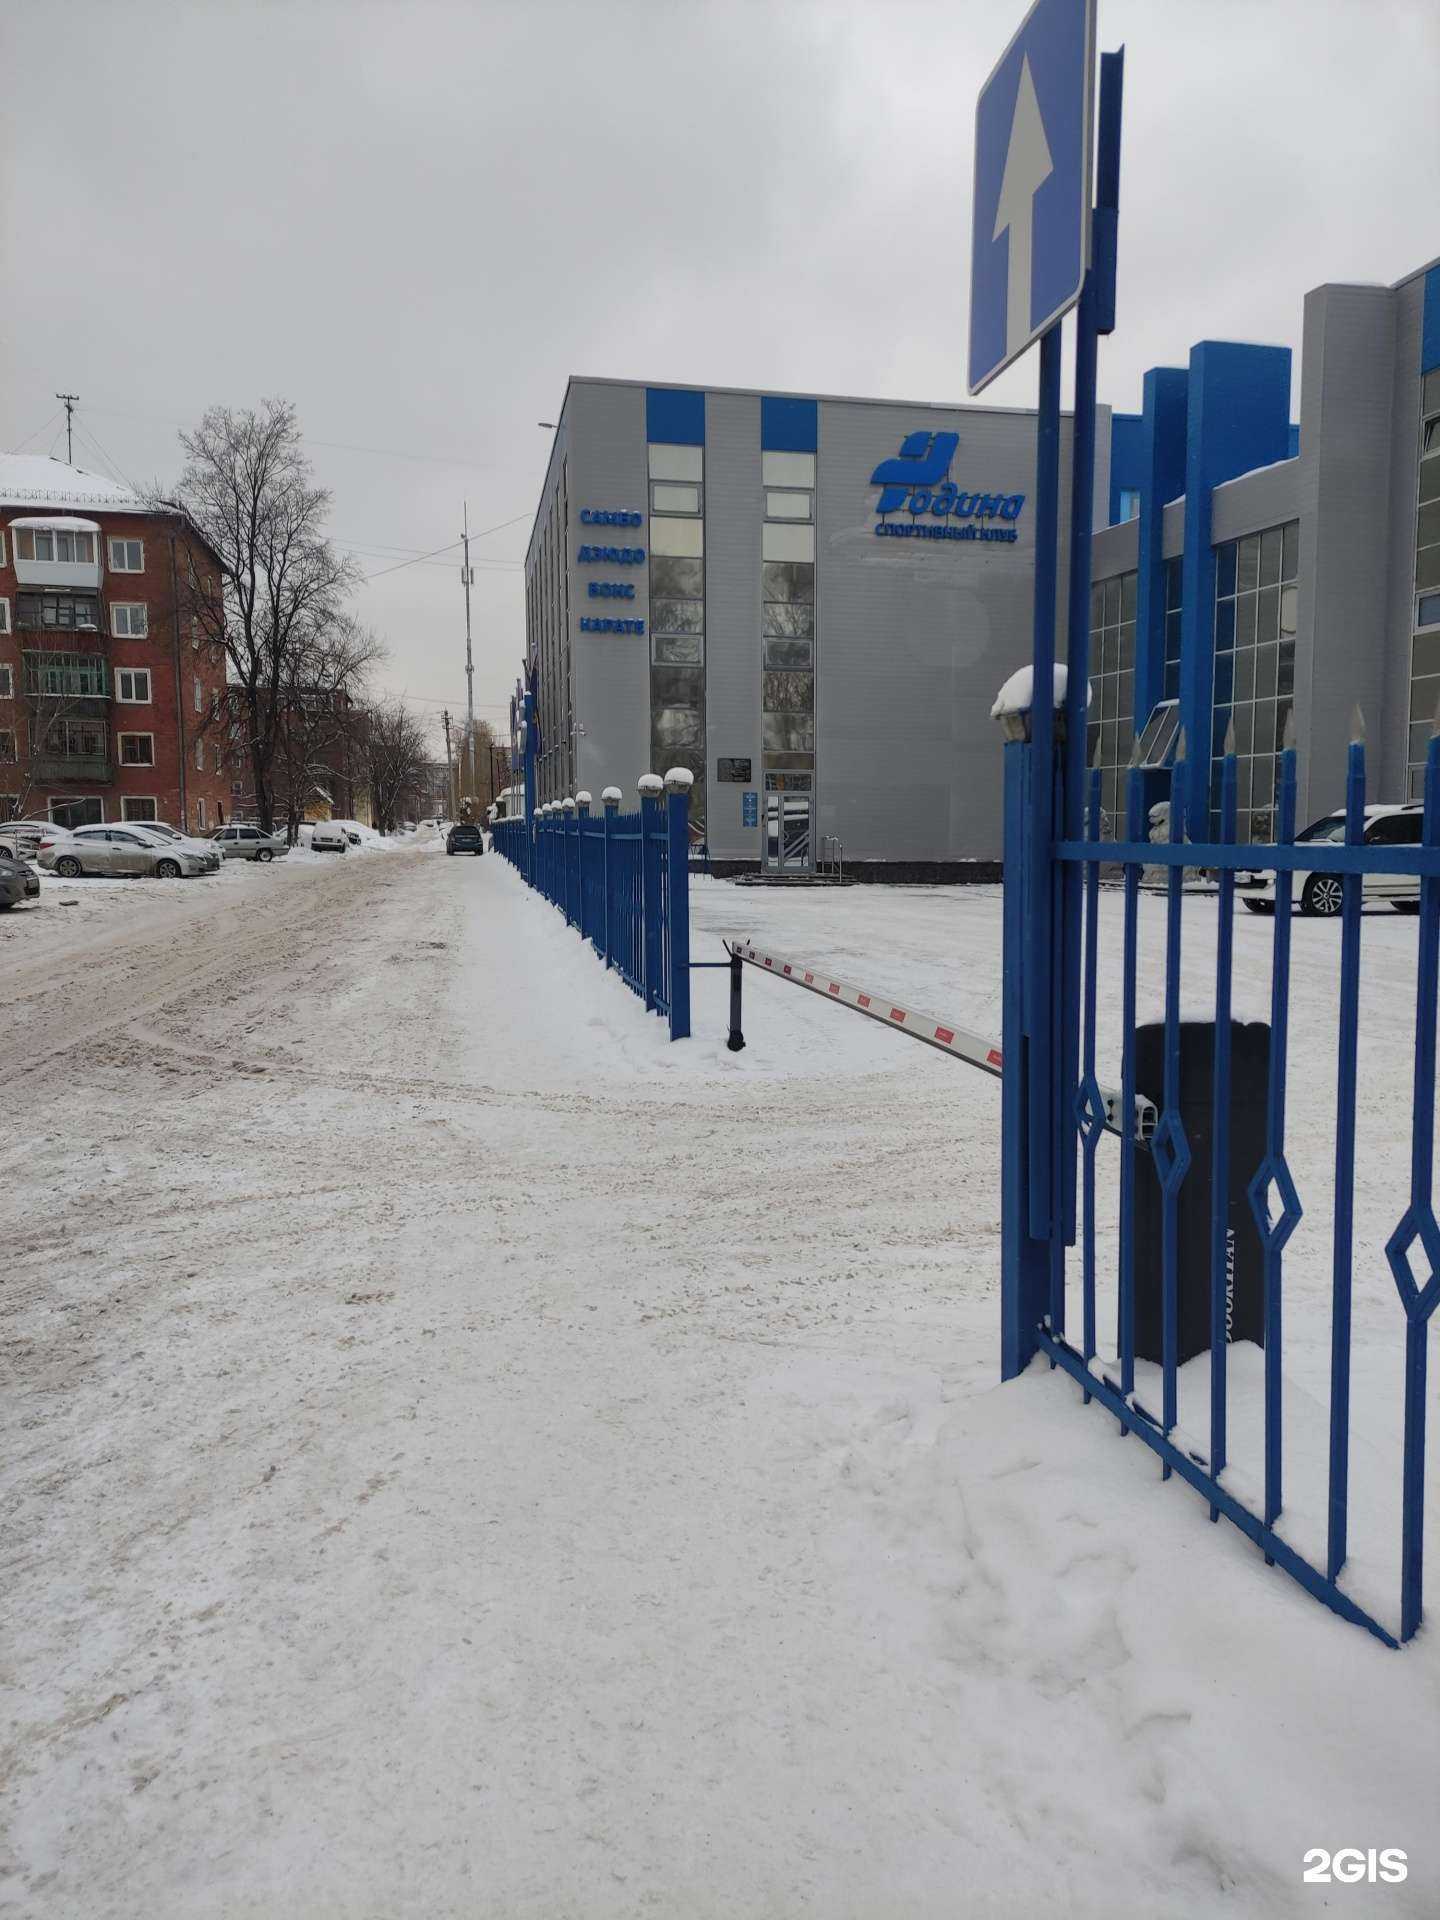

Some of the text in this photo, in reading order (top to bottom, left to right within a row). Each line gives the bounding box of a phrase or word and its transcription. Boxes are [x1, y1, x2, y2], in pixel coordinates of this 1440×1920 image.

[875, 522, 1018, 543] СПОРТИВНЫЙ КЛУБ
[588, 581, 635, 600] БОКС
[580, 616, 645, 636] КАРАТЕ
